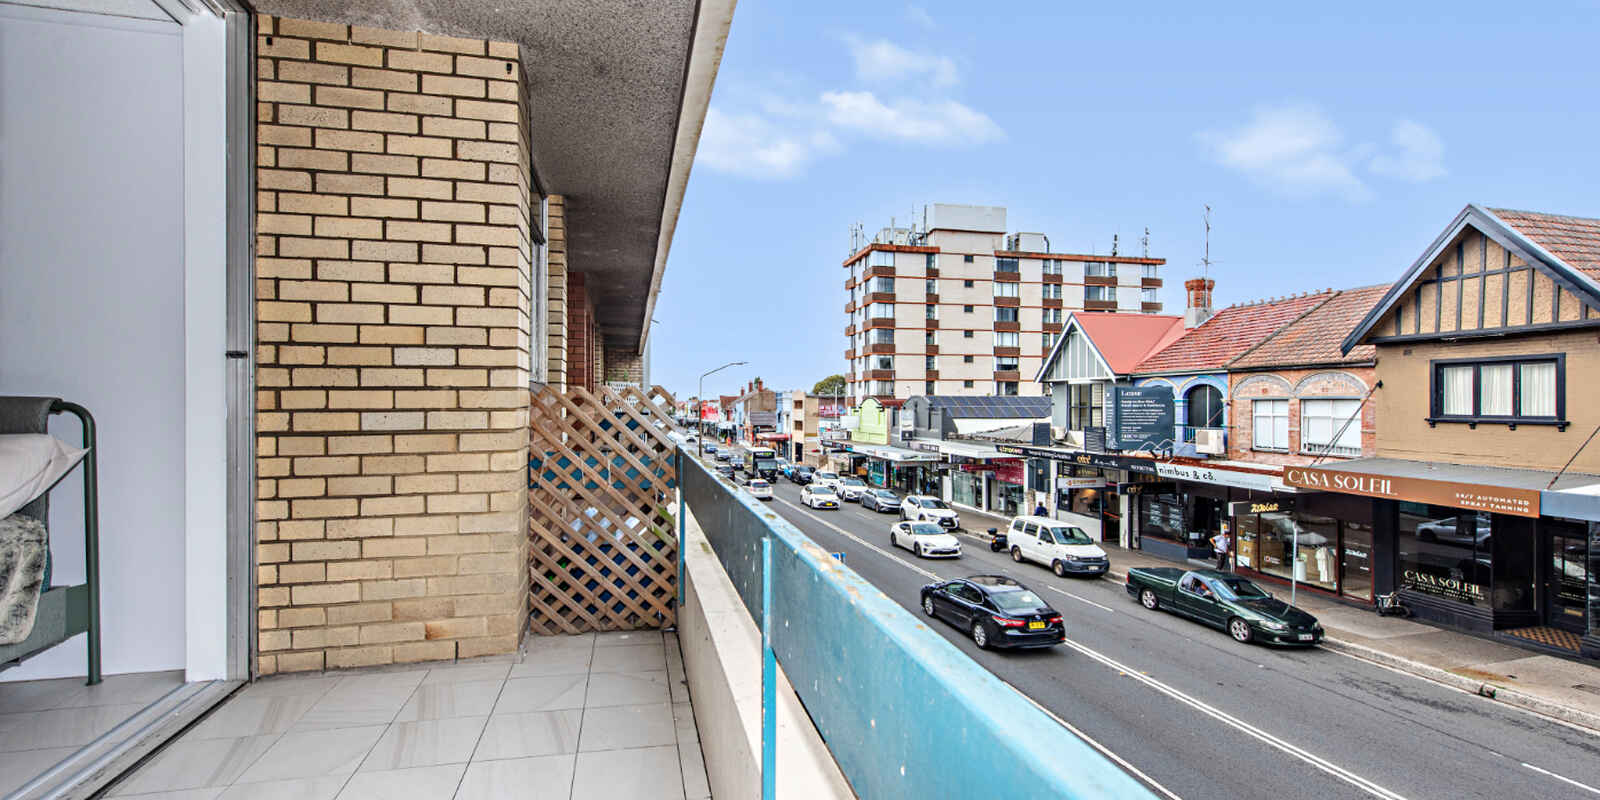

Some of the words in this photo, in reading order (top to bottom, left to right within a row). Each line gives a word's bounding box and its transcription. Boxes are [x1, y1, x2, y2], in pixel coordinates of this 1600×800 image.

[1288, 469, 1329, 488] CASA
[1334, 474, 1398, 496] SOLEIL
[1460, 500, 1486, 508] SPRAY
[1489, 503, 1529, 513] TANNING
[1476, 495, 1530, 506] AUTOMATED
[1404, 569, 1436, 586] CASA
[1438, 577, 1484, 596] SOLEIL
